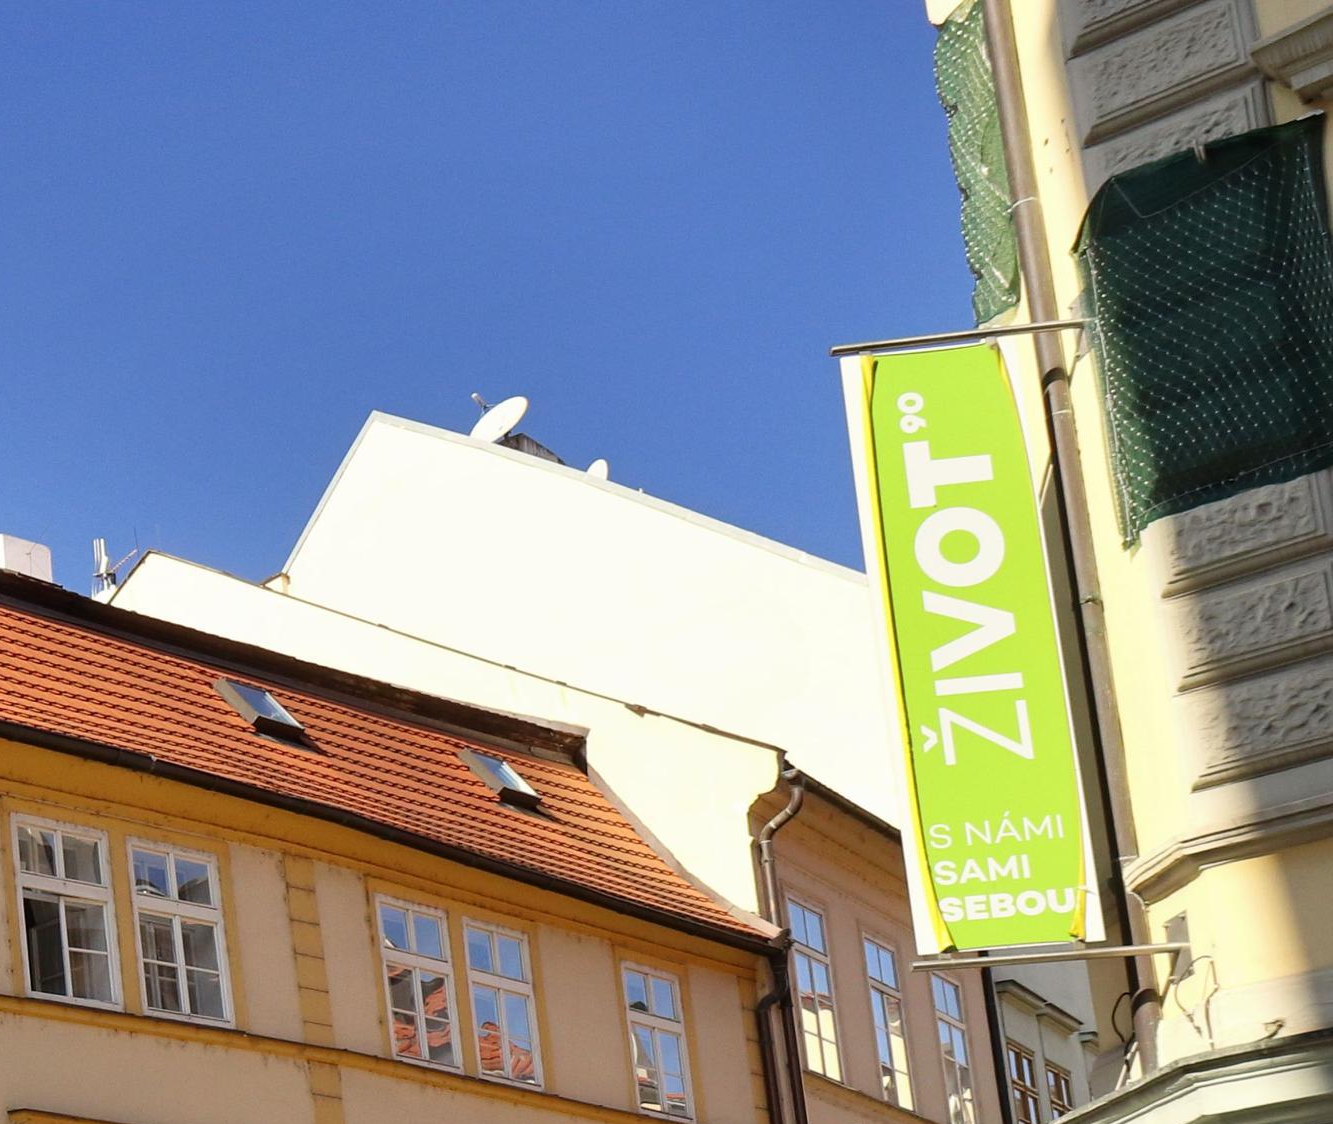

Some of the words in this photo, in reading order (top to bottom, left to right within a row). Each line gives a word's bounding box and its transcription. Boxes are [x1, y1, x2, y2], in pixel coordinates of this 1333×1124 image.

[897, 392, 926, 434] 90
[902, 440, 1035, 766] ŽIVOT
[929, 823, 953, 849] S
[964, 811, 1065, 846] NÁMI
[934, 854, 1031, 886] SAMI
[938, 887, 1075, 923] SEBOU
